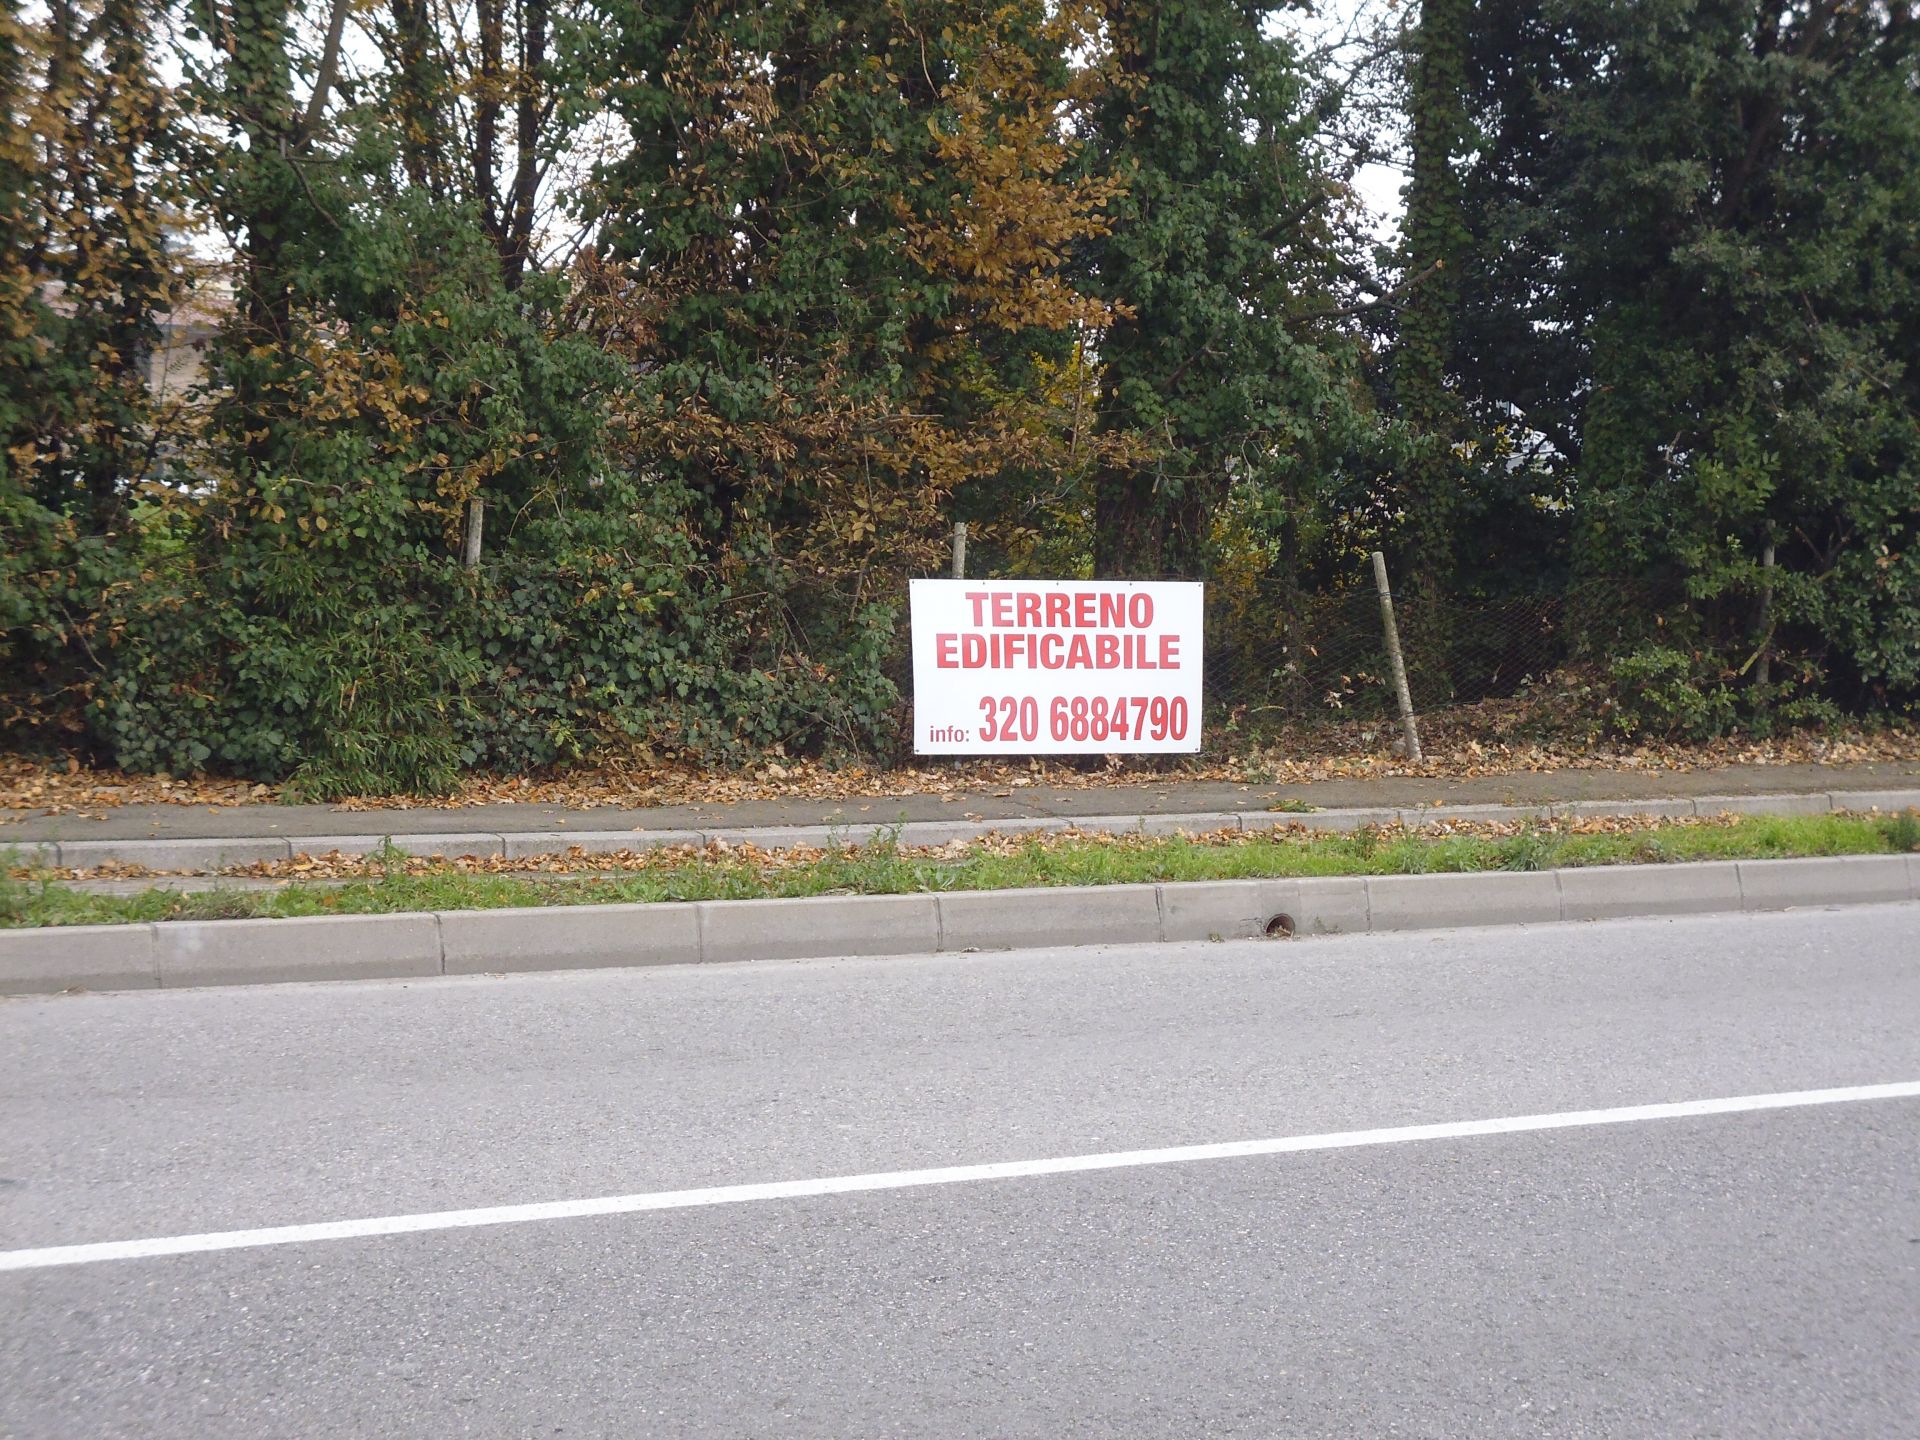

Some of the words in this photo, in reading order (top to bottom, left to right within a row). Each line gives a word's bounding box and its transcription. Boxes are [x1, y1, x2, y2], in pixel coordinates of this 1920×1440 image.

[965, 592, 1154, 628] TERRENO
[936, 633, 1181, 670] EDIFICABILE
[929, 725, 970, 743] info:
[979, 696, 1039, 742] 320
[1050, 695, 1188, 742] 6884790
